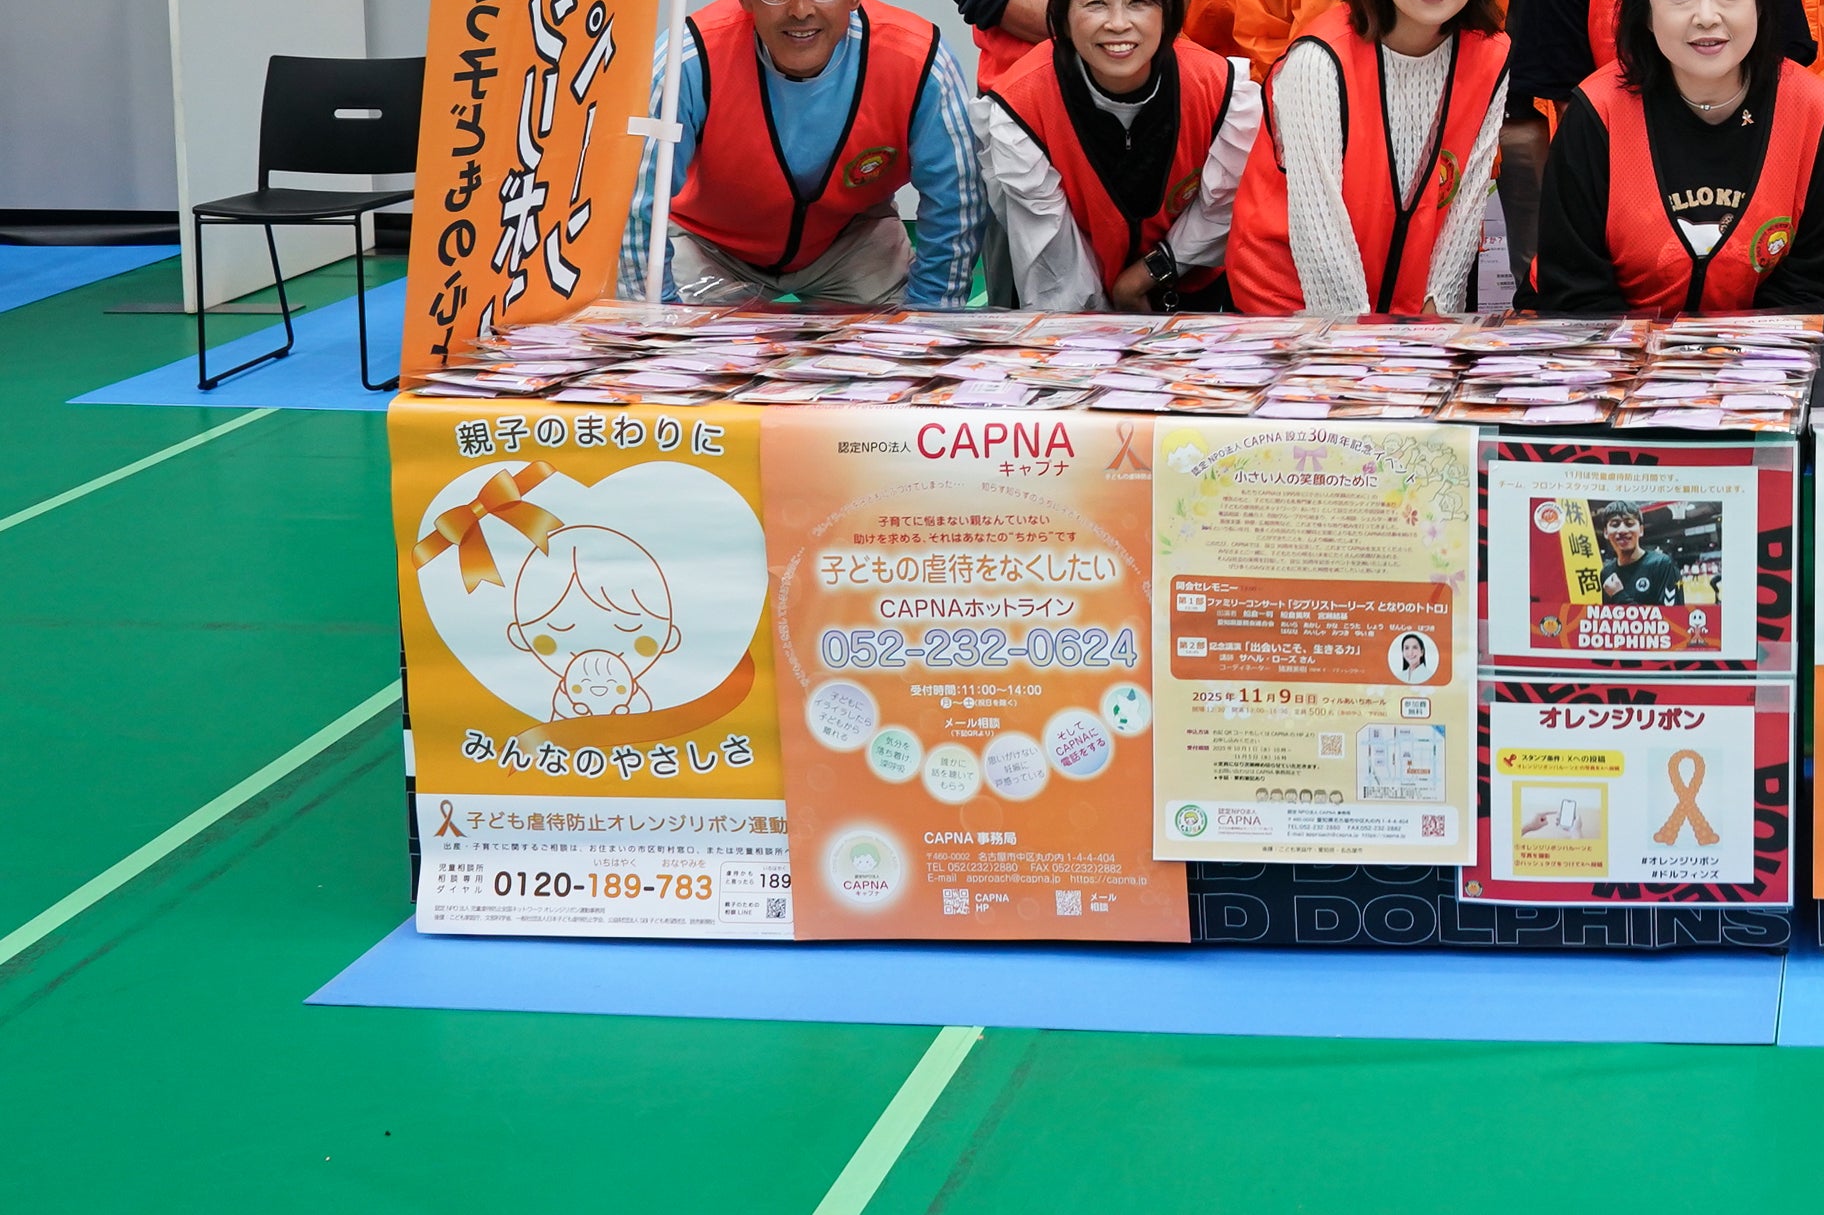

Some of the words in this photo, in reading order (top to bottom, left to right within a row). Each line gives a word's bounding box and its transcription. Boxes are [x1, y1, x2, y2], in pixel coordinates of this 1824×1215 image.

[1715, 187, 1747, 209] KI
[457, 414, 725, 457] 親子のまわりに
[837, 441, 912, 454] 認定NPO法人
[916, 421, 1075, 459] CAPNA
[1243, 433, 1283, 449] CAPNA
[1000, 459, 1070, 477] キャプナ
[1234, 470, 1378, 488] 小さい人の笑顔のために
[878, 515, 1051, 527] 子育てに悩まない親なんていない
[820, 552, 1117, 584] 子どもの虐待をなくしたい
[879, 597, 1076, 619] CAPNAホットライン
[1586, 605, 1663, 621] NAGOYA
[1579, 620, 1670, 636] DIAMOND
[821, 627, 1139, 669] 052-232-0624
[1577, 634, 1672, 650] DOLPHINS
[1539, 706, 1706, 731] オレンジリボン
[1056, 720, 1085, 741] そして
[1055, 727, 1099, 757] CAPNAに
[461, 728, 755, 779] みんなのやさしさ
[1060, 738, 1107, 768] 電話をする
[466, 811, 788, 834] 子ども虐待防止オレンジリボン運動
[1217, 815, 1262, 826] CAPNA
[923, 831, 974, 844] CAPNA
[439, 863, 484, 872] 児童相談所
[593, 858, 638, 868] いちはやく
[661, 858, 707, 869] おなやみを
[926, 862, 945, 872] TEL
[1030, 862, 1050, 872] FAX
[437, 874, 483, 883] 相談専用
[494, 870, 712, 900] 0120-189-783
[760, 873, 791, 889] 189
[843, 880, 889, 890] CAPNA
[927, 873, 957, 883] E-mail
[436, 885, 483, 894] ダイヤル
[1090, 893, 1117, 902] メール
[974, 893, 1010, 903] CAPNA
[975, 903, 990, 912] HP
